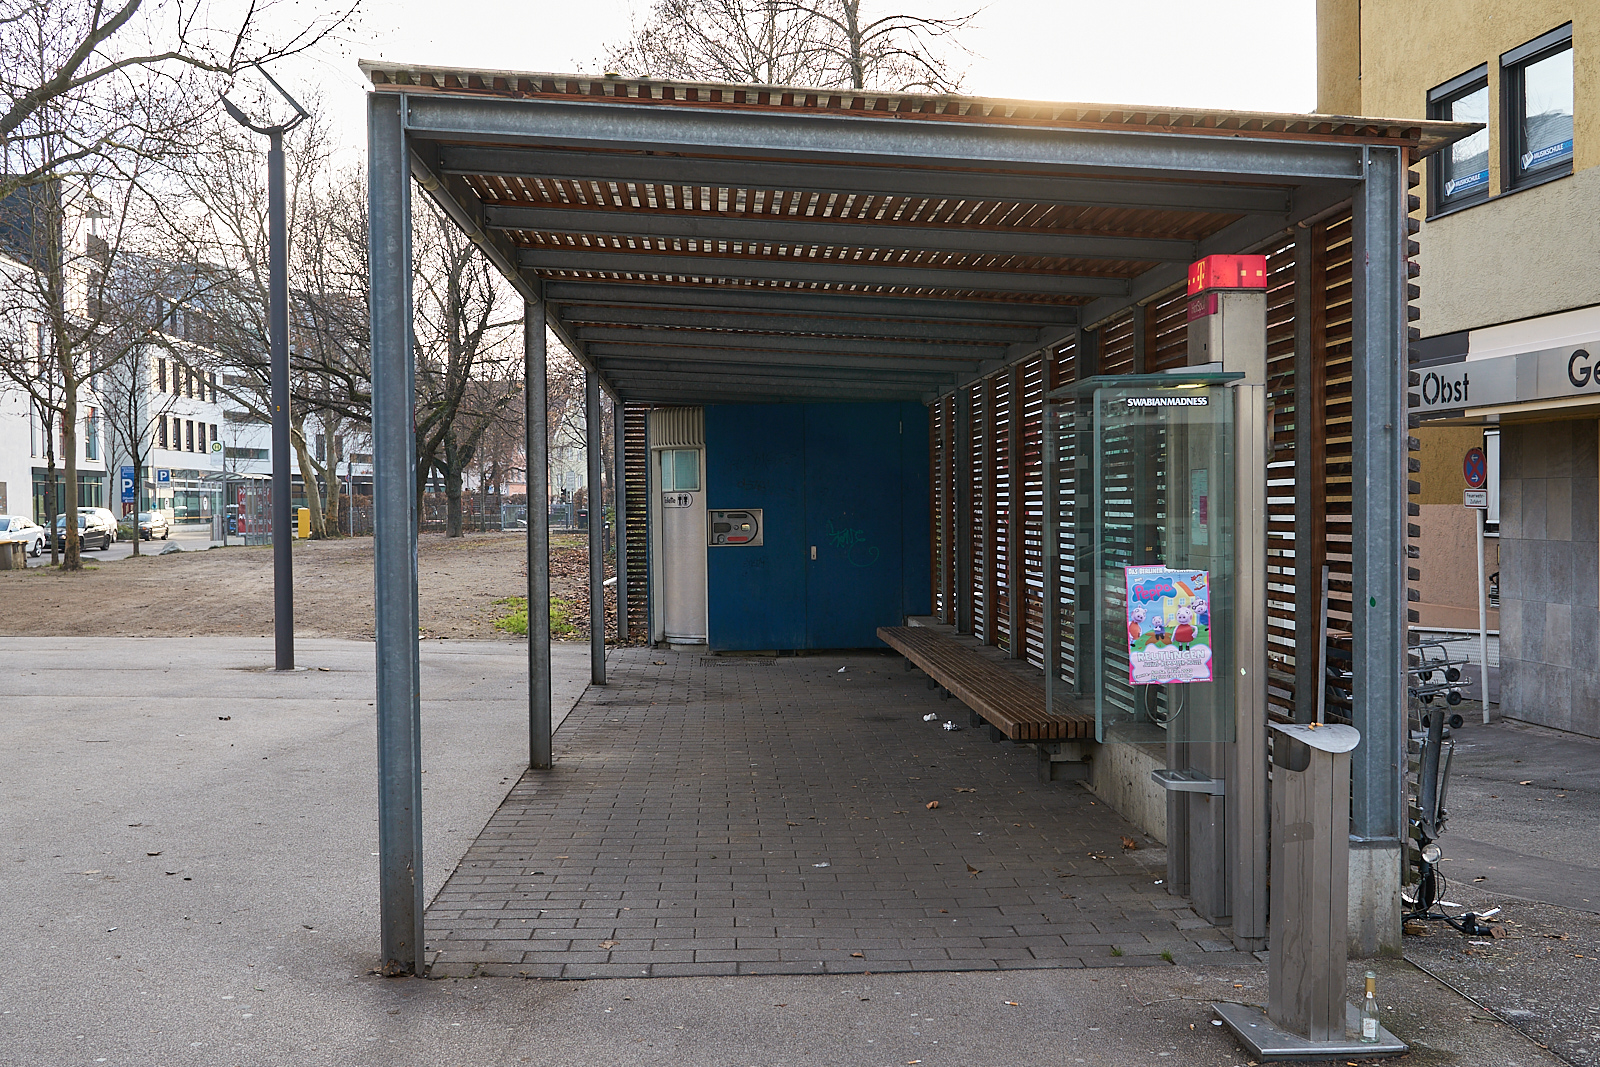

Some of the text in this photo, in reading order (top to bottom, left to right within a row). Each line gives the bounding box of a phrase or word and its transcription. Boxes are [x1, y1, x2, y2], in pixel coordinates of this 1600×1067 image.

[1534, 143, 1563, 160] MUSIKSCHULE
[1455, 173, 1480, 187] MUSIKSCHULE
[1422, 372, 1469, 405] Obst
[1127, 397, 1207, 407] SWABIANMADNESS
[160, 471, 168, 481] P
[122, 479, 134, 493] P
[1135, 583, 1172, 601] Peppa
